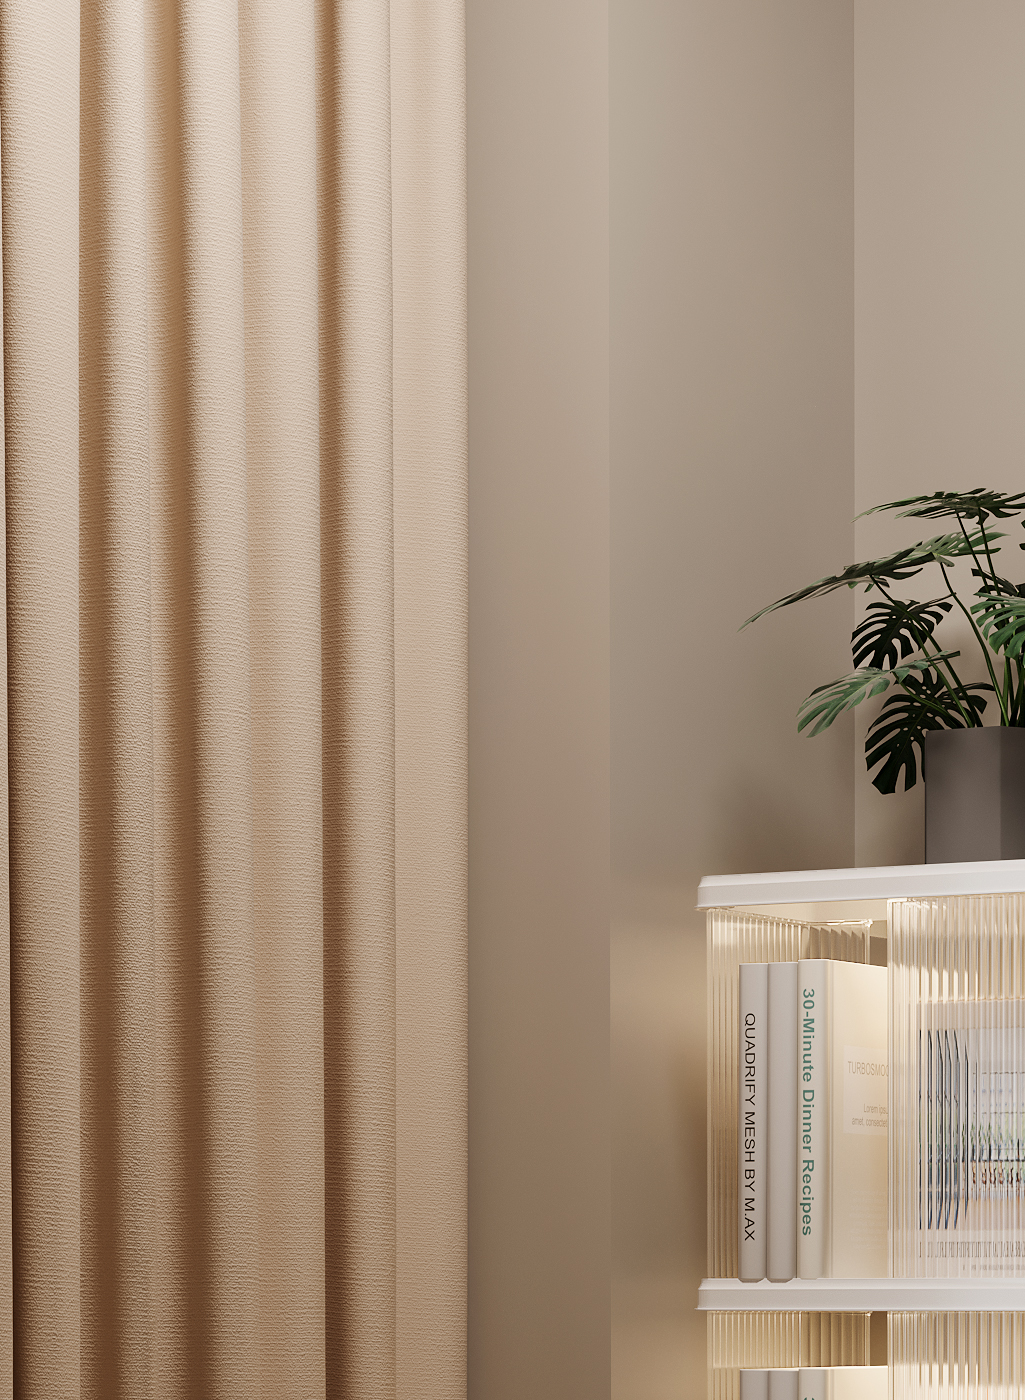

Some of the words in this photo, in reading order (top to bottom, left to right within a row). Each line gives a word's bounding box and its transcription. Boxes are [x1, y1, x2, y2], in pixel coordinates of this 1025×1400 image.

[745, 1013, 756, 1105] QUADRIFY
[803, 989, 815, 1082] 30-Minute
[745, 1111, 756, 1162] MESH
[803, 1090, 815, 1153] Dinner
[745, 1169, 756, 1192] BY
[799, 1160, 815, 1236] Recipes
[745, 1198, 756, 1241] M.AX
